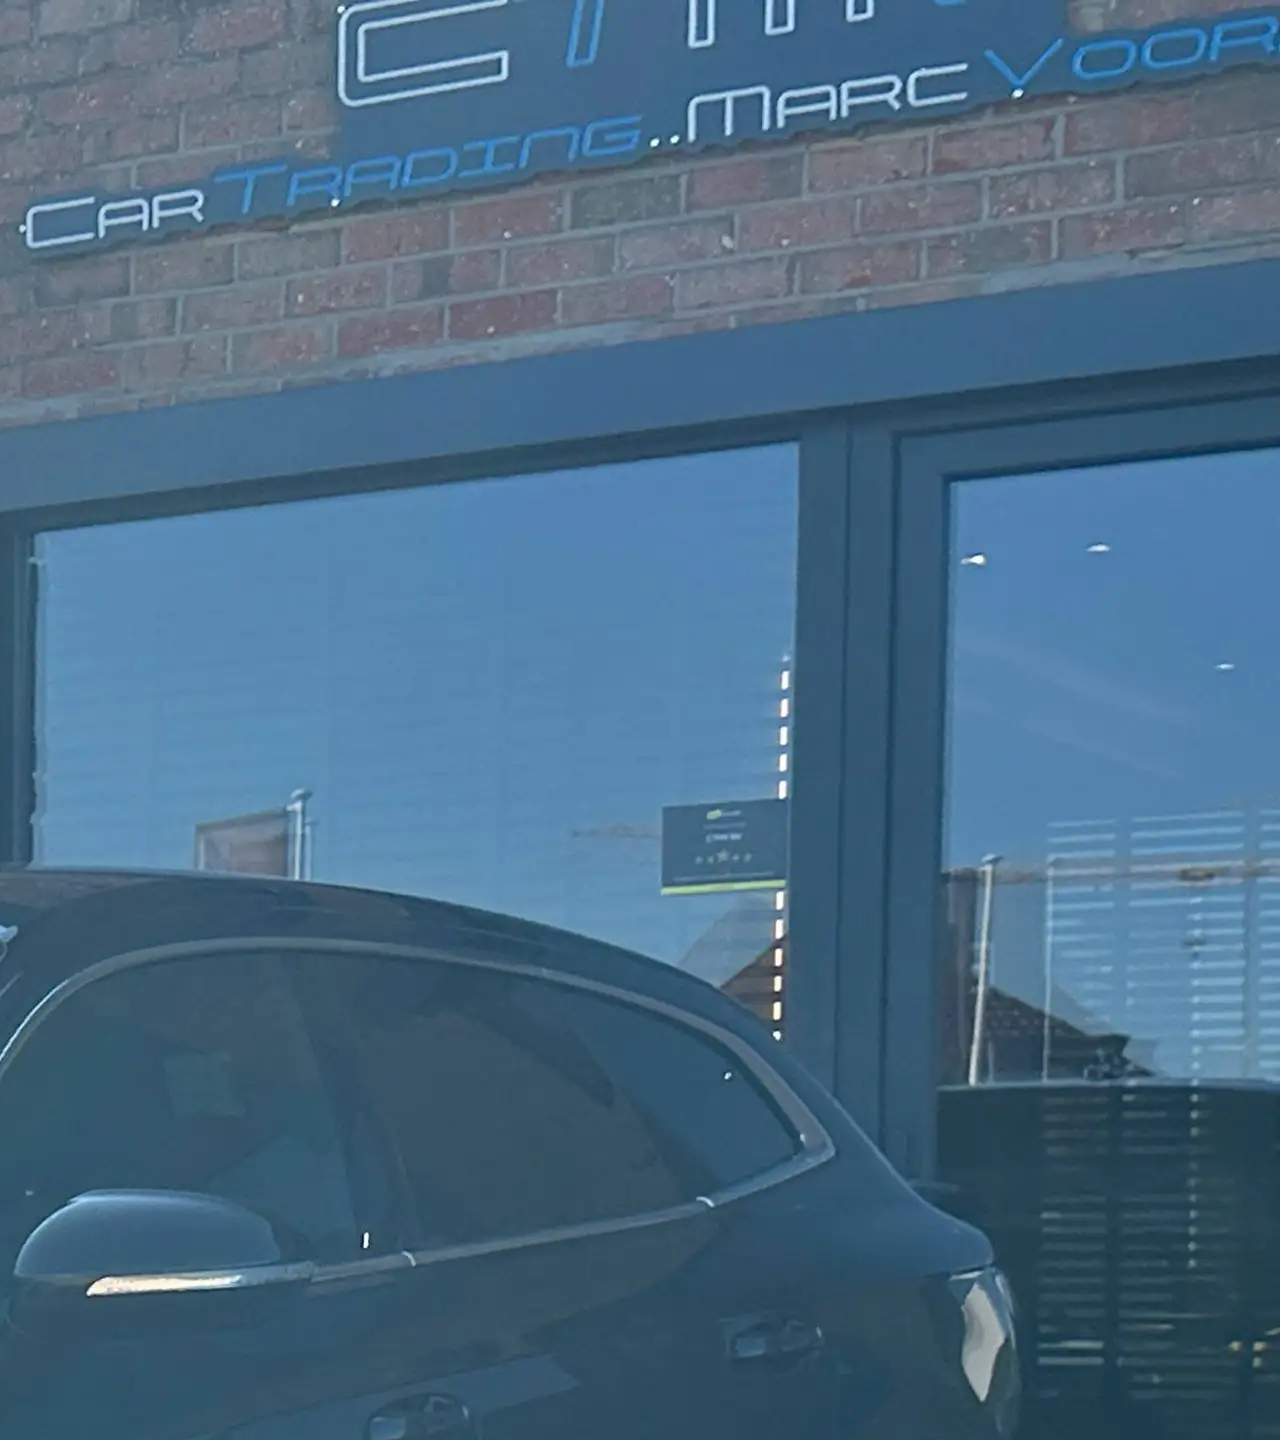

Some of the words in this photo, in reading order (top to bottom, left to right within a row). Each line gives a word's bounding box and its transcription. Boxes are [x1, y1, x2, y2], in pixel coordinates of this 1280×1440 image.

[25, 188, 205, 250] CAR
[212, 113, 645, 214] TRADING
[686, 63, 970, 143] MARC
[984, 15, 1280, 91] VOOR
